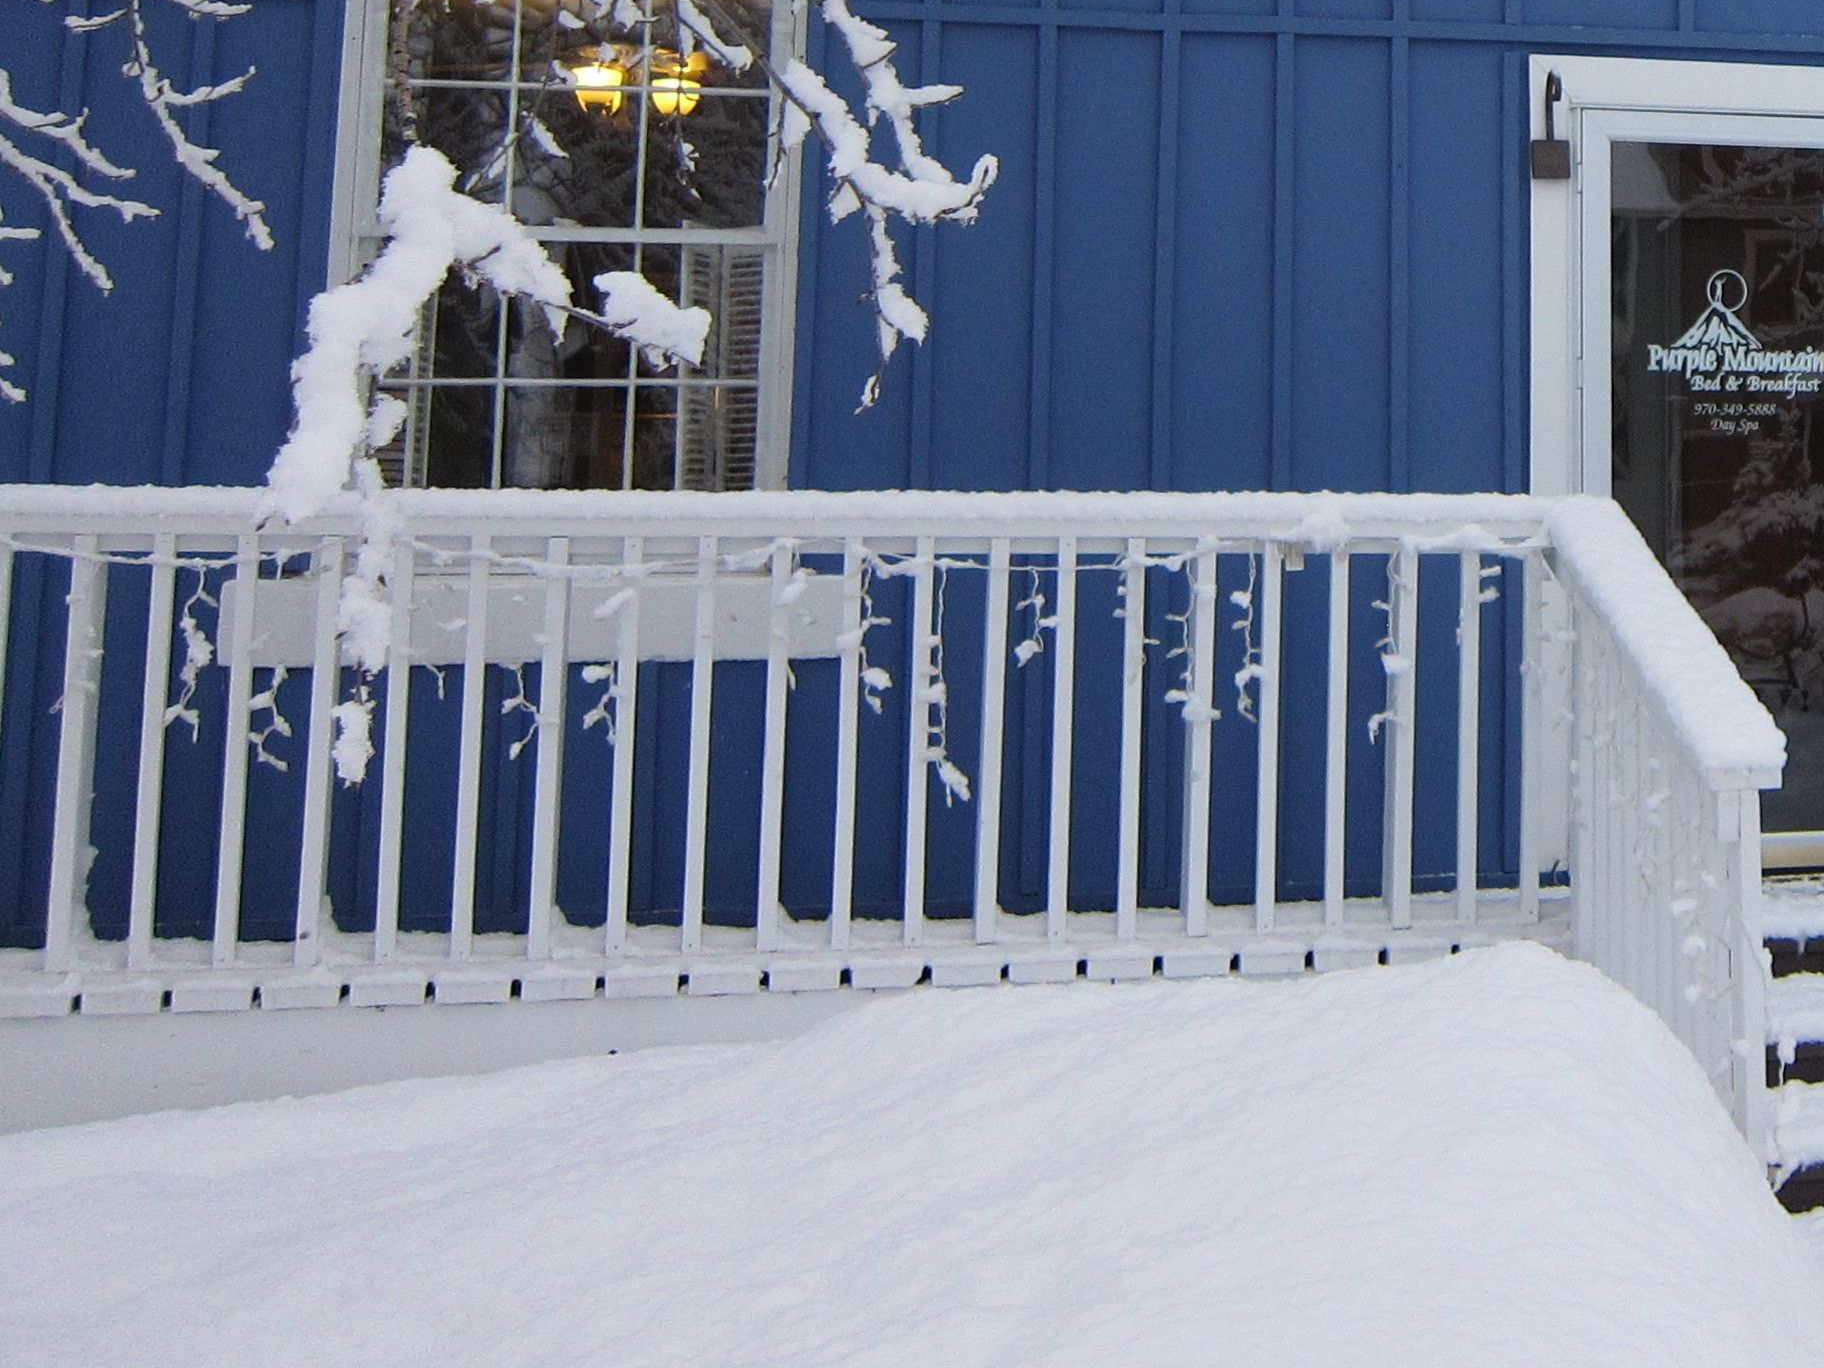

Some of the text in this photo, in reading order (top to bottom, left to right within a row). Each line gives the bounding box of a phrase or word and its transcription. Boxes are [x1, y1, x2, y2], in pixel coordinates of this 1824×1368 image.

[1647, 344, 1718, 379] Purple
[1690, 372, 1822, 400] Bed & Breakfast
[1711, 418, 1760, 435] Day Spa
